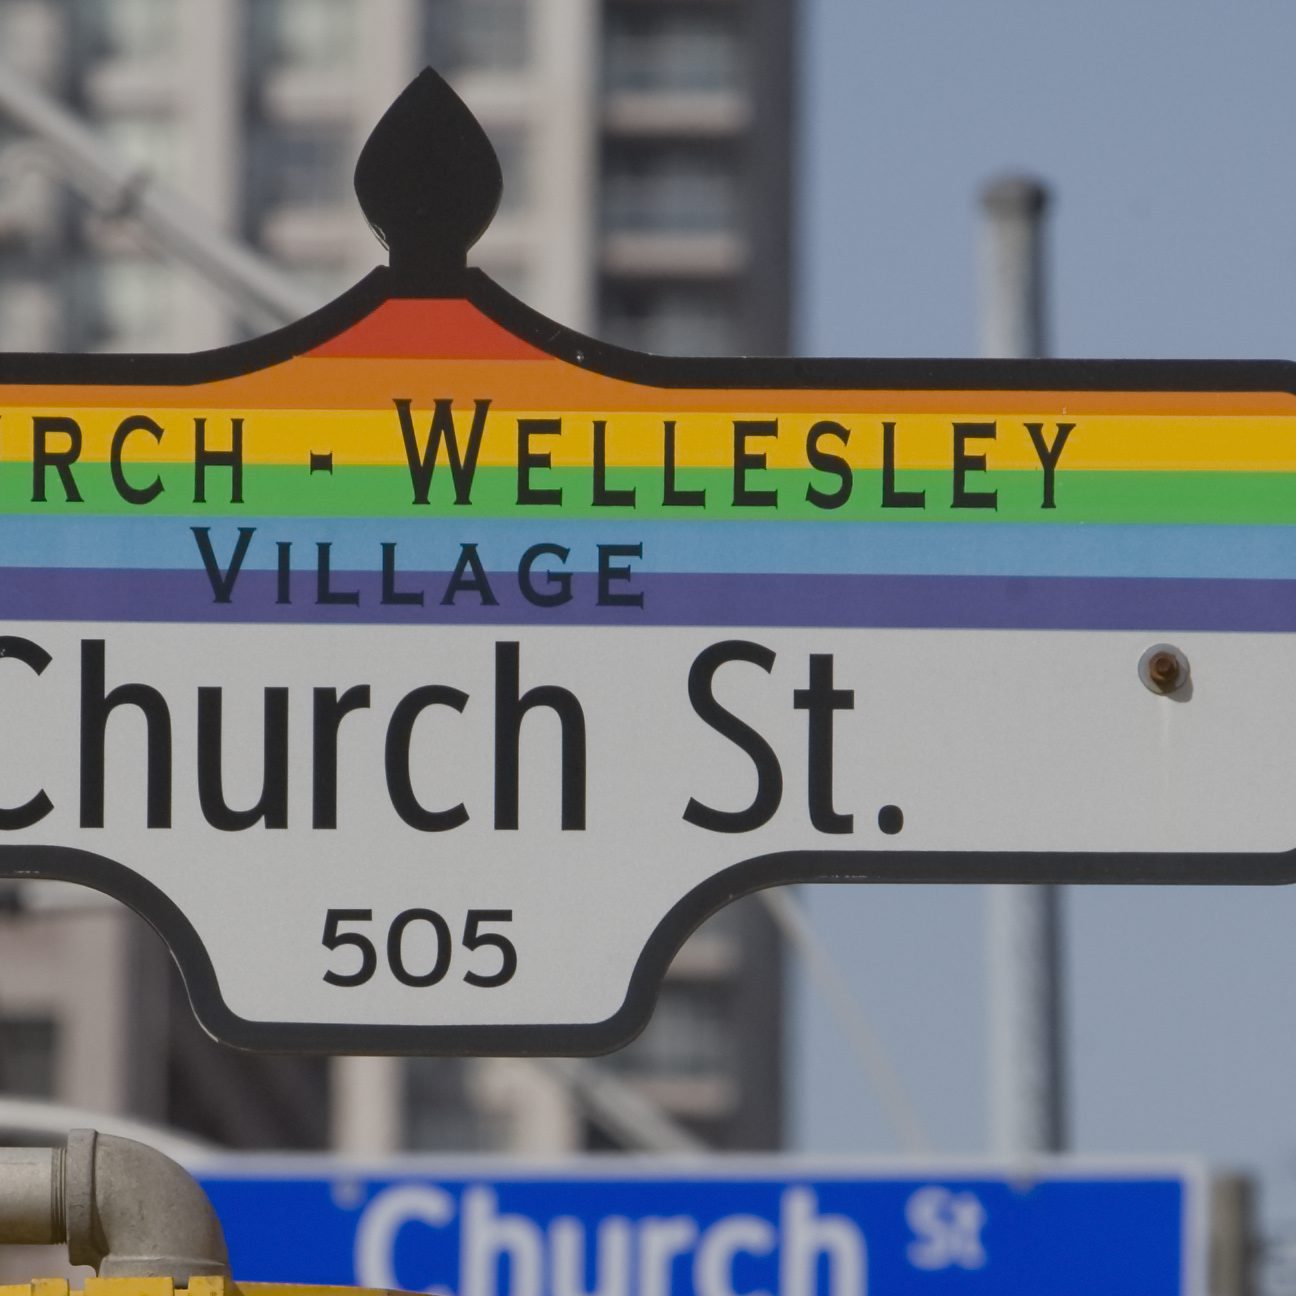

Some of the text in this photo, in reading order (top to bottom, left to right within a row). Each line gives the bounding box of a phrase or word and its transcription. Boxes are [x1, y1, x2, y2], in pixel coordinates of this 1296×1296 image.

[190, 525, 645, 609] VILLAGE
[681, 638, 906, 836] St.
[320, 907, 518, 988] 505
[905, 1184, 987, 1271] St
